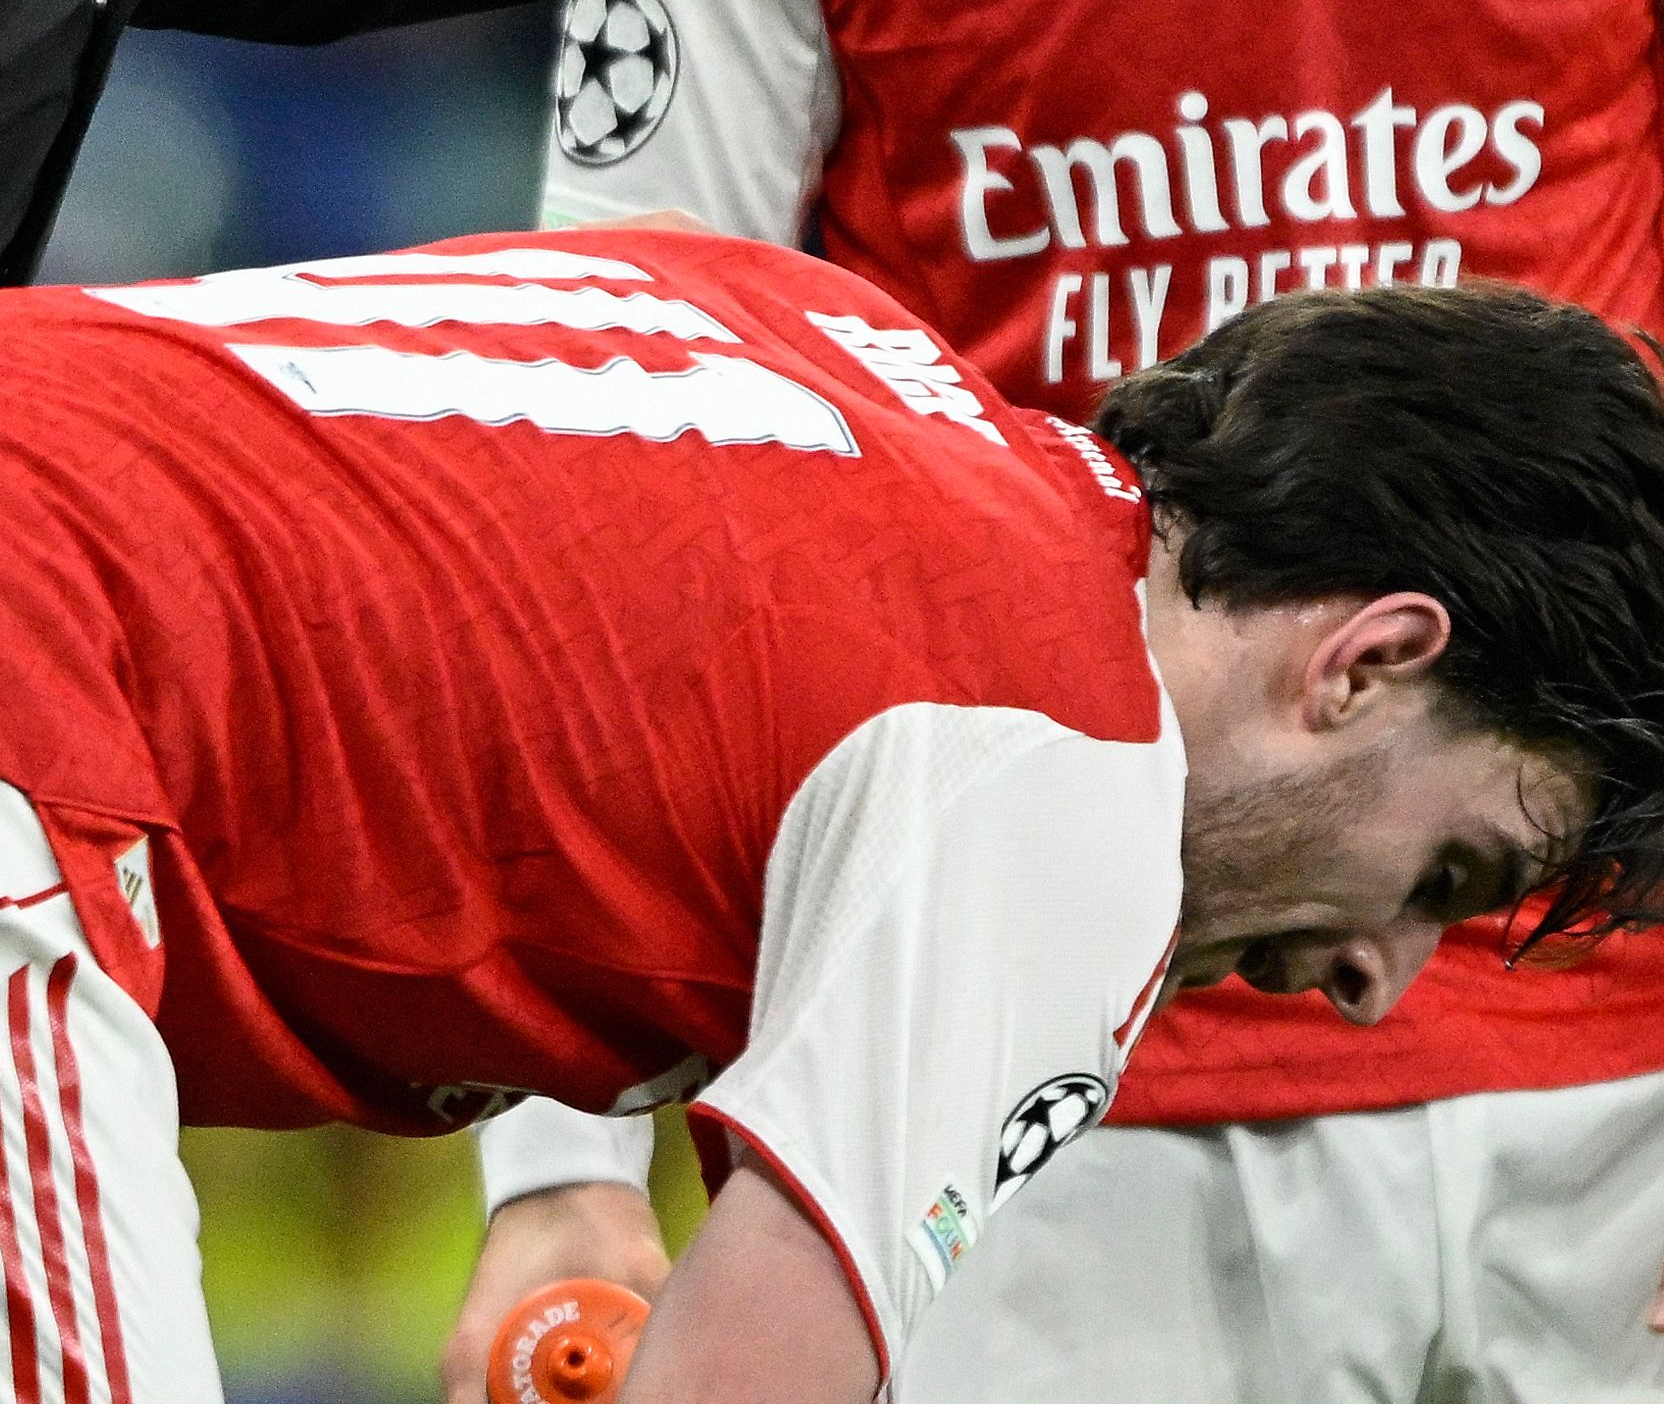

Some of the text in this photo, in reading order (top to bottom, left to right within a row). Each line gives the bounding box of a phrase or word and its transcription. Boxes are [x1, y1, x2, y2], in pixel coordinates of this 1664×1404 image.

[949, 87, 1546, 262] Emirates
[1046, 263, 1173, 384] FLY
[1045, 415, 1142, 504] Arsenal
[943, 1183, 968, 1218] UEFA
[512, 1299, 581, 1404] ATORADE
